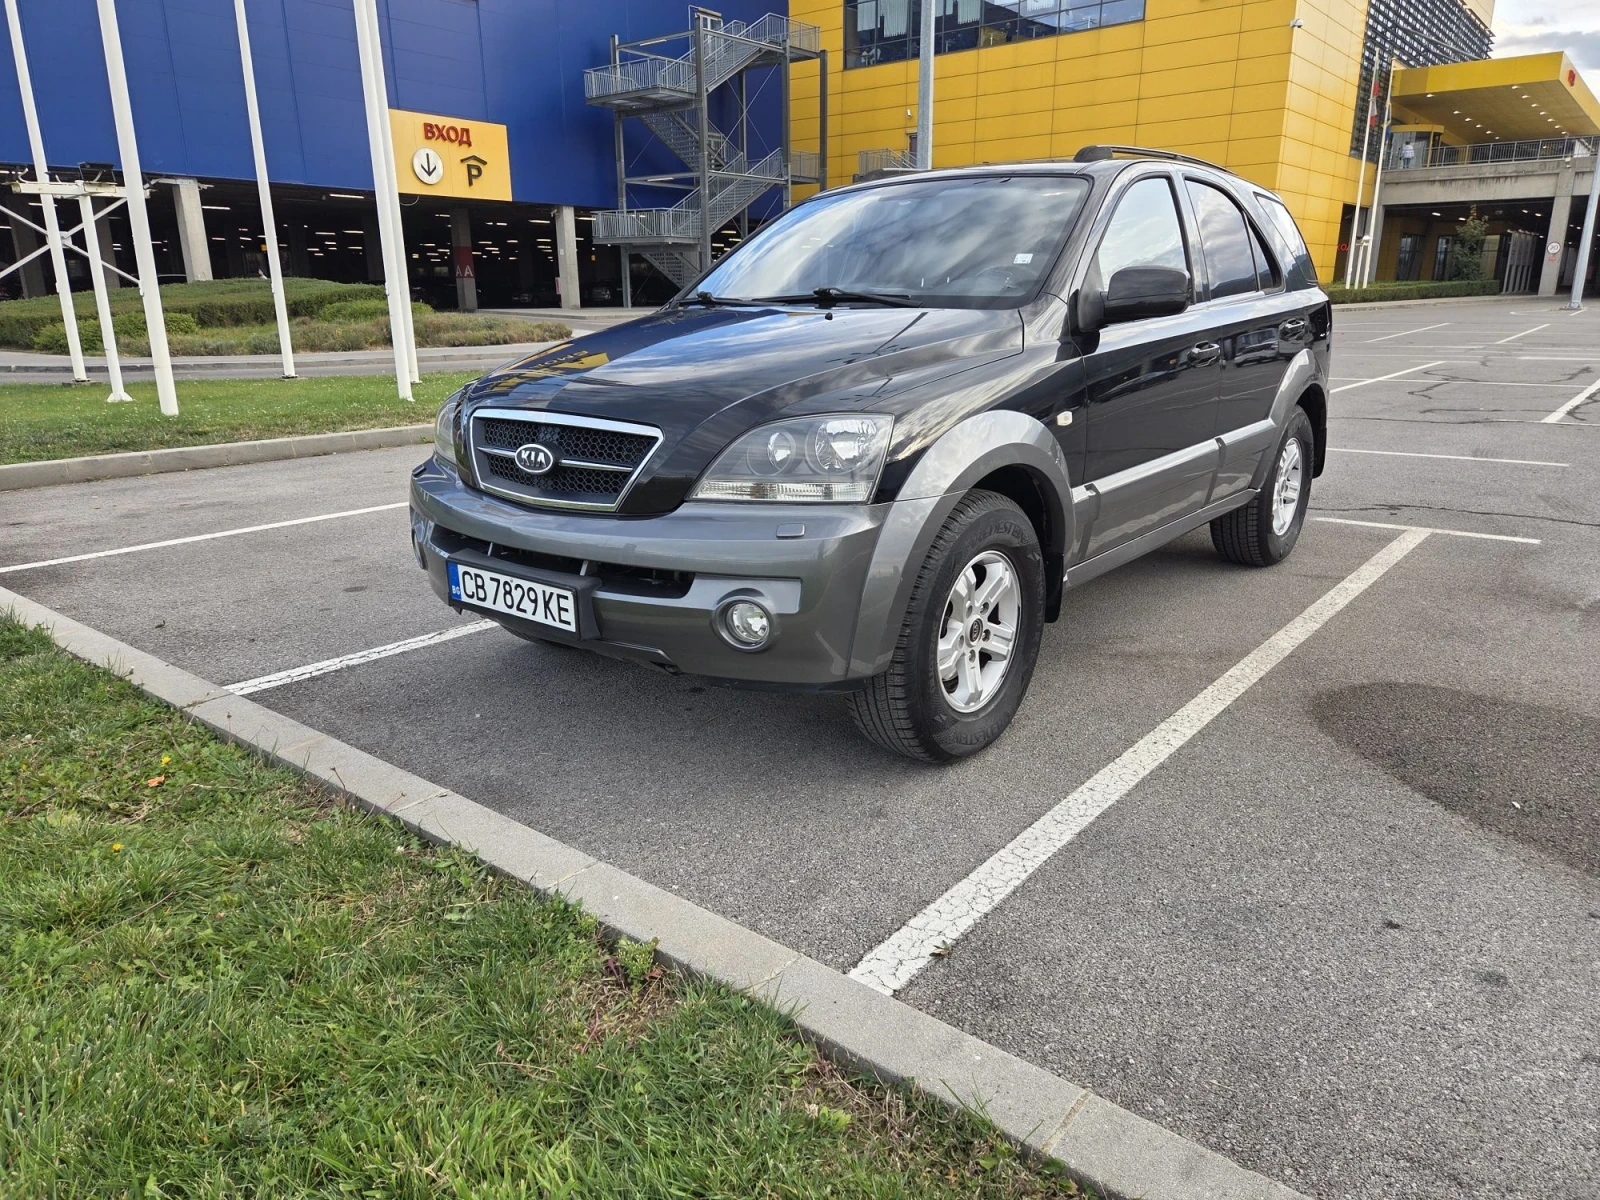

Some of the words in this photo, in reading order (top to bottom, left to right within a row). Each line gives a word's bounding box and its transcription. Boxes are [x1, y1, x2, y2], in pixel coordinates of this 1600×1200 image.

[423, 122, 472, 148] ВХОД
[464, 265, 474, 276] A
[521, 449, 546, 467] KIA
[452, 585, 461, 595] BG
